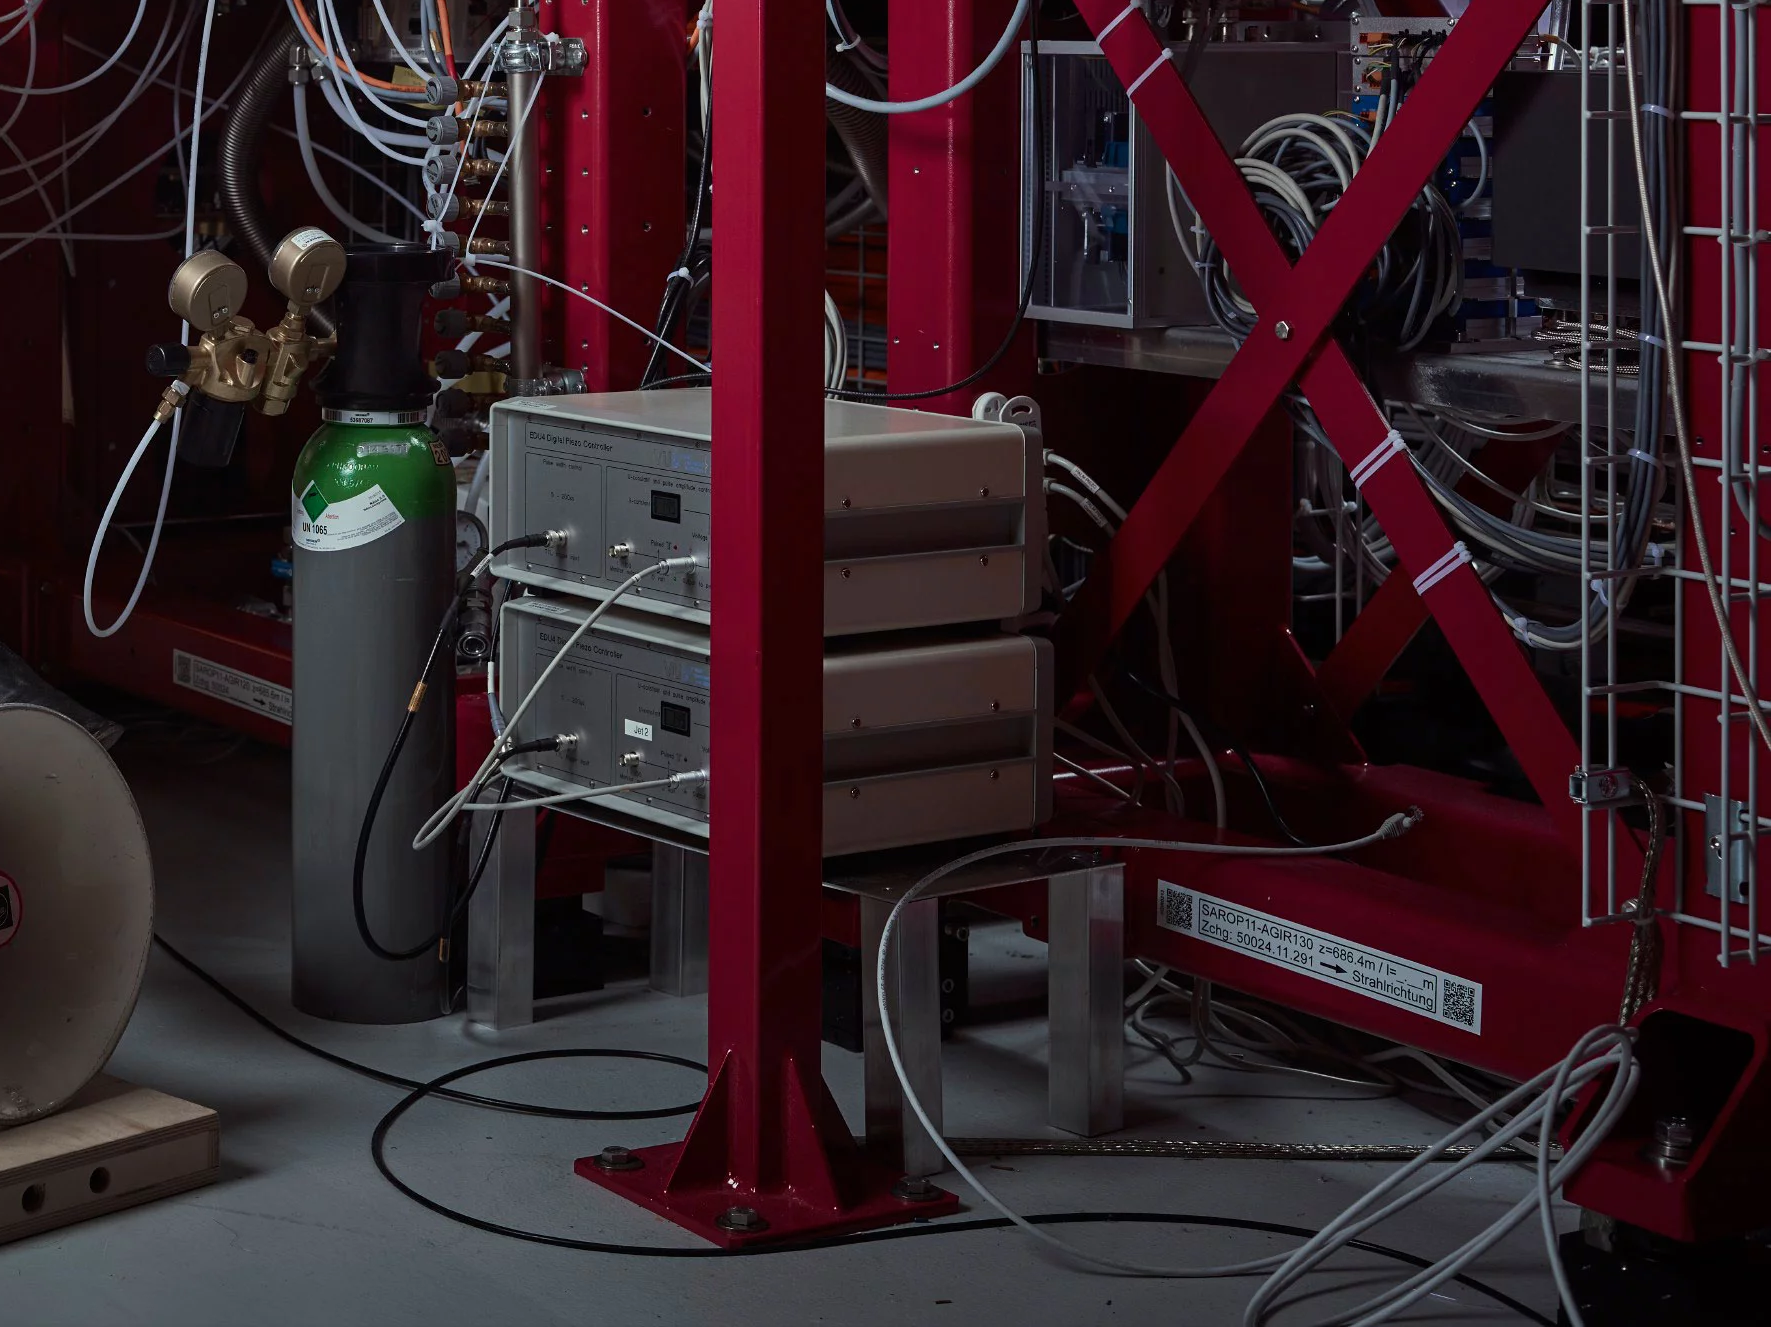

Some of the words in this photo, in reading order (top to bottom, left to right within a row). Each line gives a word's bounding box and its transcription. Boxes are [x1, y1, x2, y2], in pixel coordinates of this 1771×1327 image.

[583, 439, 613, 452] Controller
[302, 522, 311, 533] UN
[312, 524, 328, 535] 1065
[593, 645, 623, 660] Controller
[1201, 903, 1315, 952] SAROP11-AGIR130
[1318, 942, 1377, 973] z=686.4m
[1201, 919, 1234, 942] Zchg:
[1236, 933, 1316, 968] 50024.11.291
[1351, 970, 1435, 1012] Strahlrichtung
